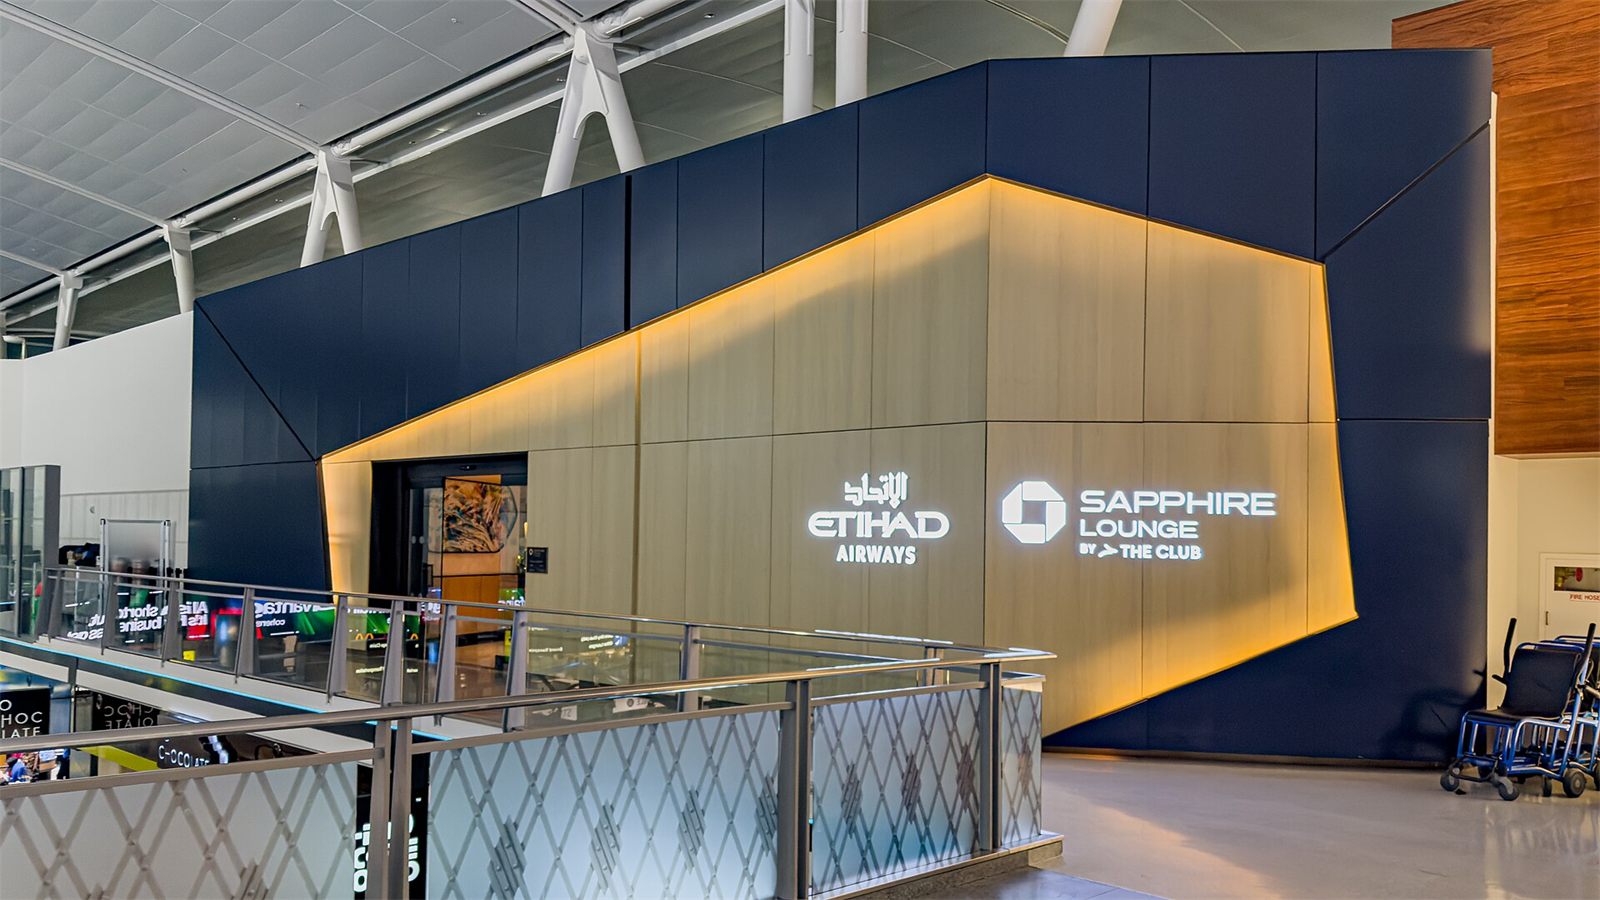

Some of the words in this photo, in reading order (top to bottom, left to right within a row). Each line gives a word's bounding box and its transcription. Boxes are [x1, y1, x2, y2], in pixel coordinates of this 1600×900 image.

[1080, 490, 1277, 516] SAPPHIRE
[808, 511, 950, 538] ETIHAD
[1080, 519, 1199, 538] LOUNGE
[836, 545, 916, 564] AIRWAYS
[1079, 543, 1097, 555] BY
[1119, 544, 1152, 559] THE
[1155, 545, 1203, 560] CLUB
